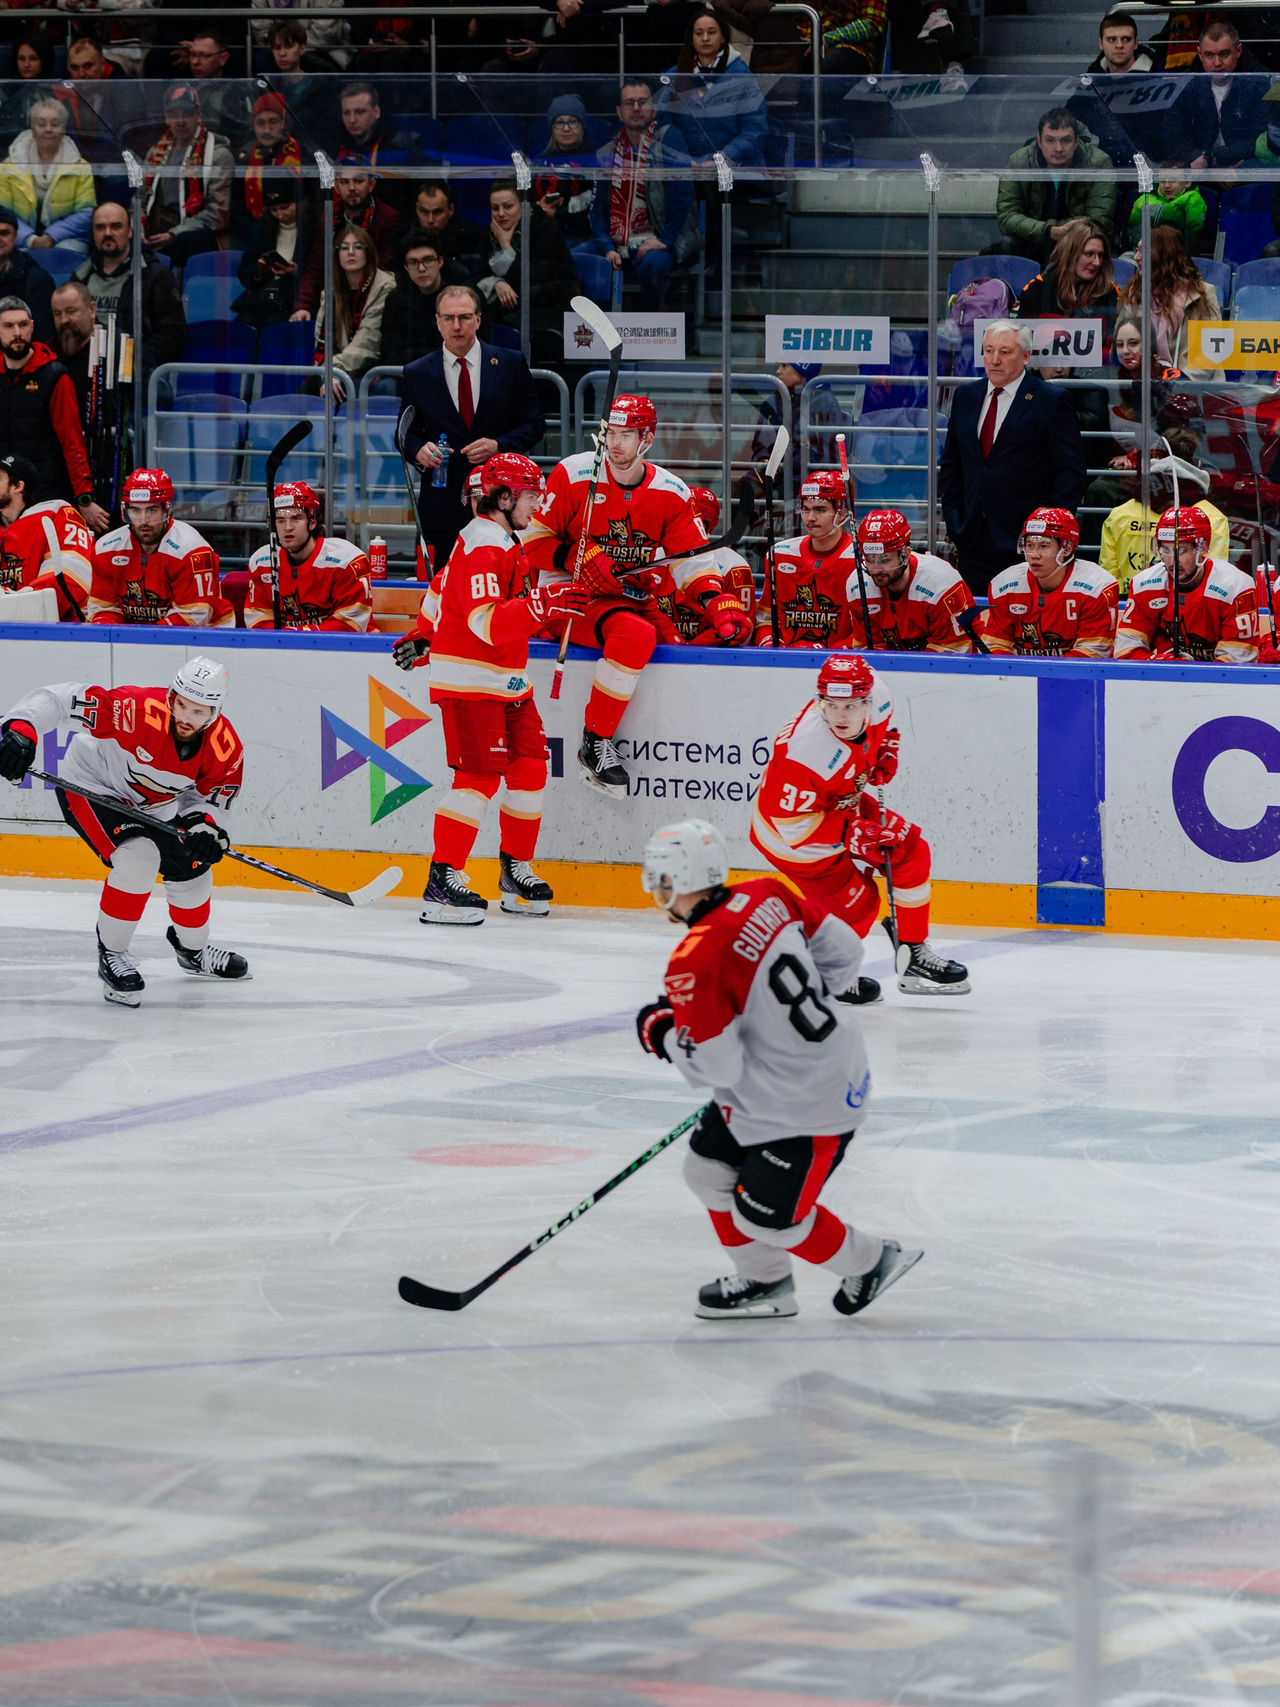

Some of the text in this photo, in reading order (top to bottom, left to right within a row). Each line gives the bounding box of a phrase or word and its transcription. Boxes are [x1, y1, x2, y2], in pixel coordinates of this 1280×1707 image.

[782, 328, 873, 352] SIBUR
[1240, 338, 1280, 354] БАН
[665, 478, 685, 493] SIBUR
[64, 523, 88, 549] 29
[370, 554, 387, 562] BIO
[194, 572, 214, 597] 12
[470, 572, 500, 600] 86
[915, 584, 935, 598] SIBUR
[998, 581, 1019, 593] SIBUR
[1073, 581, 1094, 592] SIBUR
[1139, 577, 1162, 587] SIBUR
[1208, 584, 1229, 598] SIBUR
[785, 610, 838, 631] REDSTAR
[1065, 599, 1077, 621] C
[1235, 612, 1260, 639] 92
[194, 667, 211, 680] 17
[184, 686, 205, 698] согаз
[70, 695, 98, 730] 17
[614, 738, 742, 765] система
[205, 784, 240, 811] 17
[625, 773, 762, 802] латежей
[778, 782, 817, 813] 32
[761, 1149, 792, 1170] CCM
[528, 1193, 596, 1252] CCM
